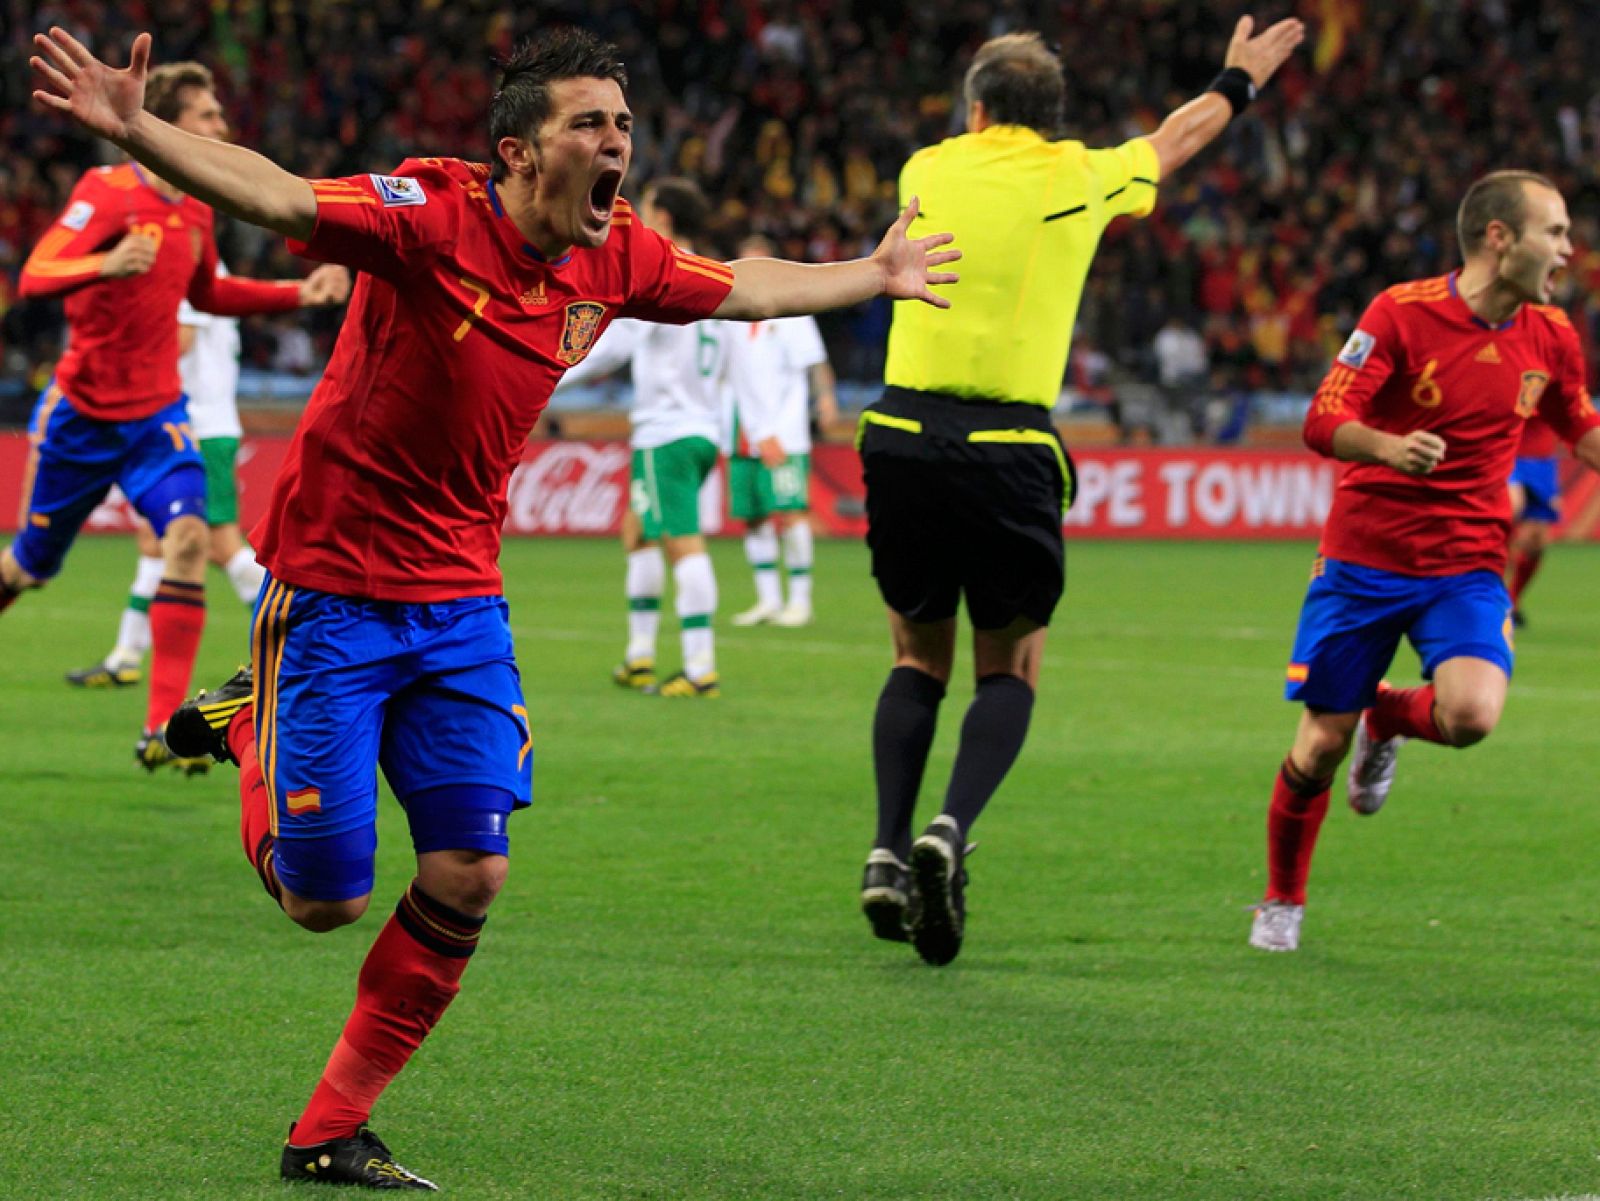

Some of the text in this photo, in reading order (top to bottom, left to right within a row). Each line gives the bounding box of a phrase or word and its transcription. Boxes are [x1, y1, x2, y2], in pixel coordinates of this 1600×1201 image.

[454, 278, 490, 341] 7
[1411, 358, 1442, 408] 6
[1067, 460, 1334, 526] PE TOWN
[511, 704, 533, 772] 7
